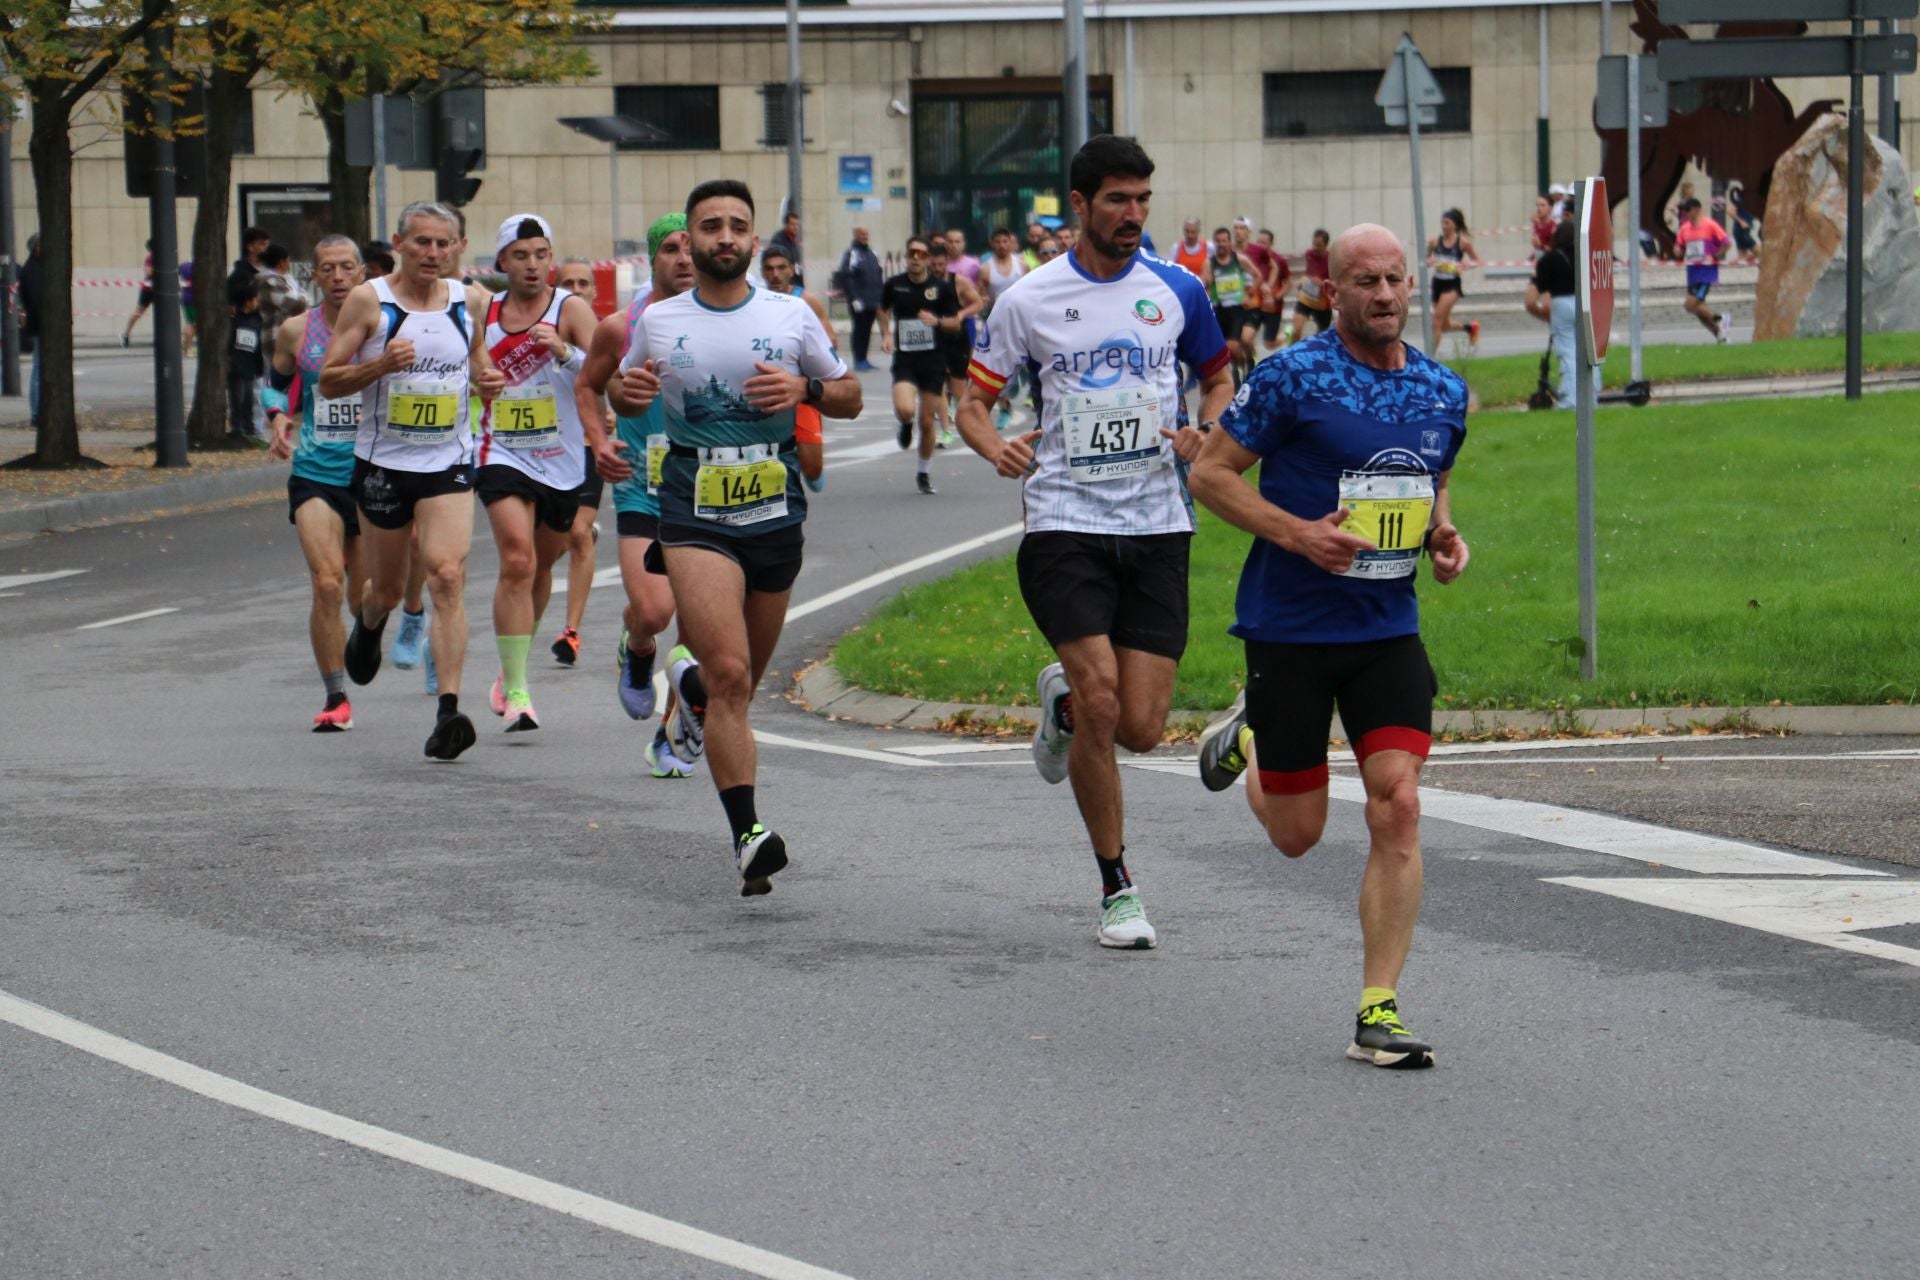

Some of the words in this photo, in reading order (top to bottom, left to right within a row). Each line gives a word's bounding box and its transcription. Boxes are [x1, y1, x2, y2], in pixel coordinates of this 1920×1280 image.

[1592, 250, 1612, 290] STOP
[1052, 340, 1172, 376] arregui
[413, 403, 437, 426] 70
[510, 407, 535, 430] 75
[1096, 410, 1133, 420] CRISTIAN
[1089, 418, 1140, 453] 437
[1106, 459, 1150, 474] HYUNDAI
[721, 473, 763, 505] 144
[731, 506, 772, 521] HYUNDAI
[1373, 501, 1412, 510] FERNANDEZ
[1378, 512, 1404, 549] 111
